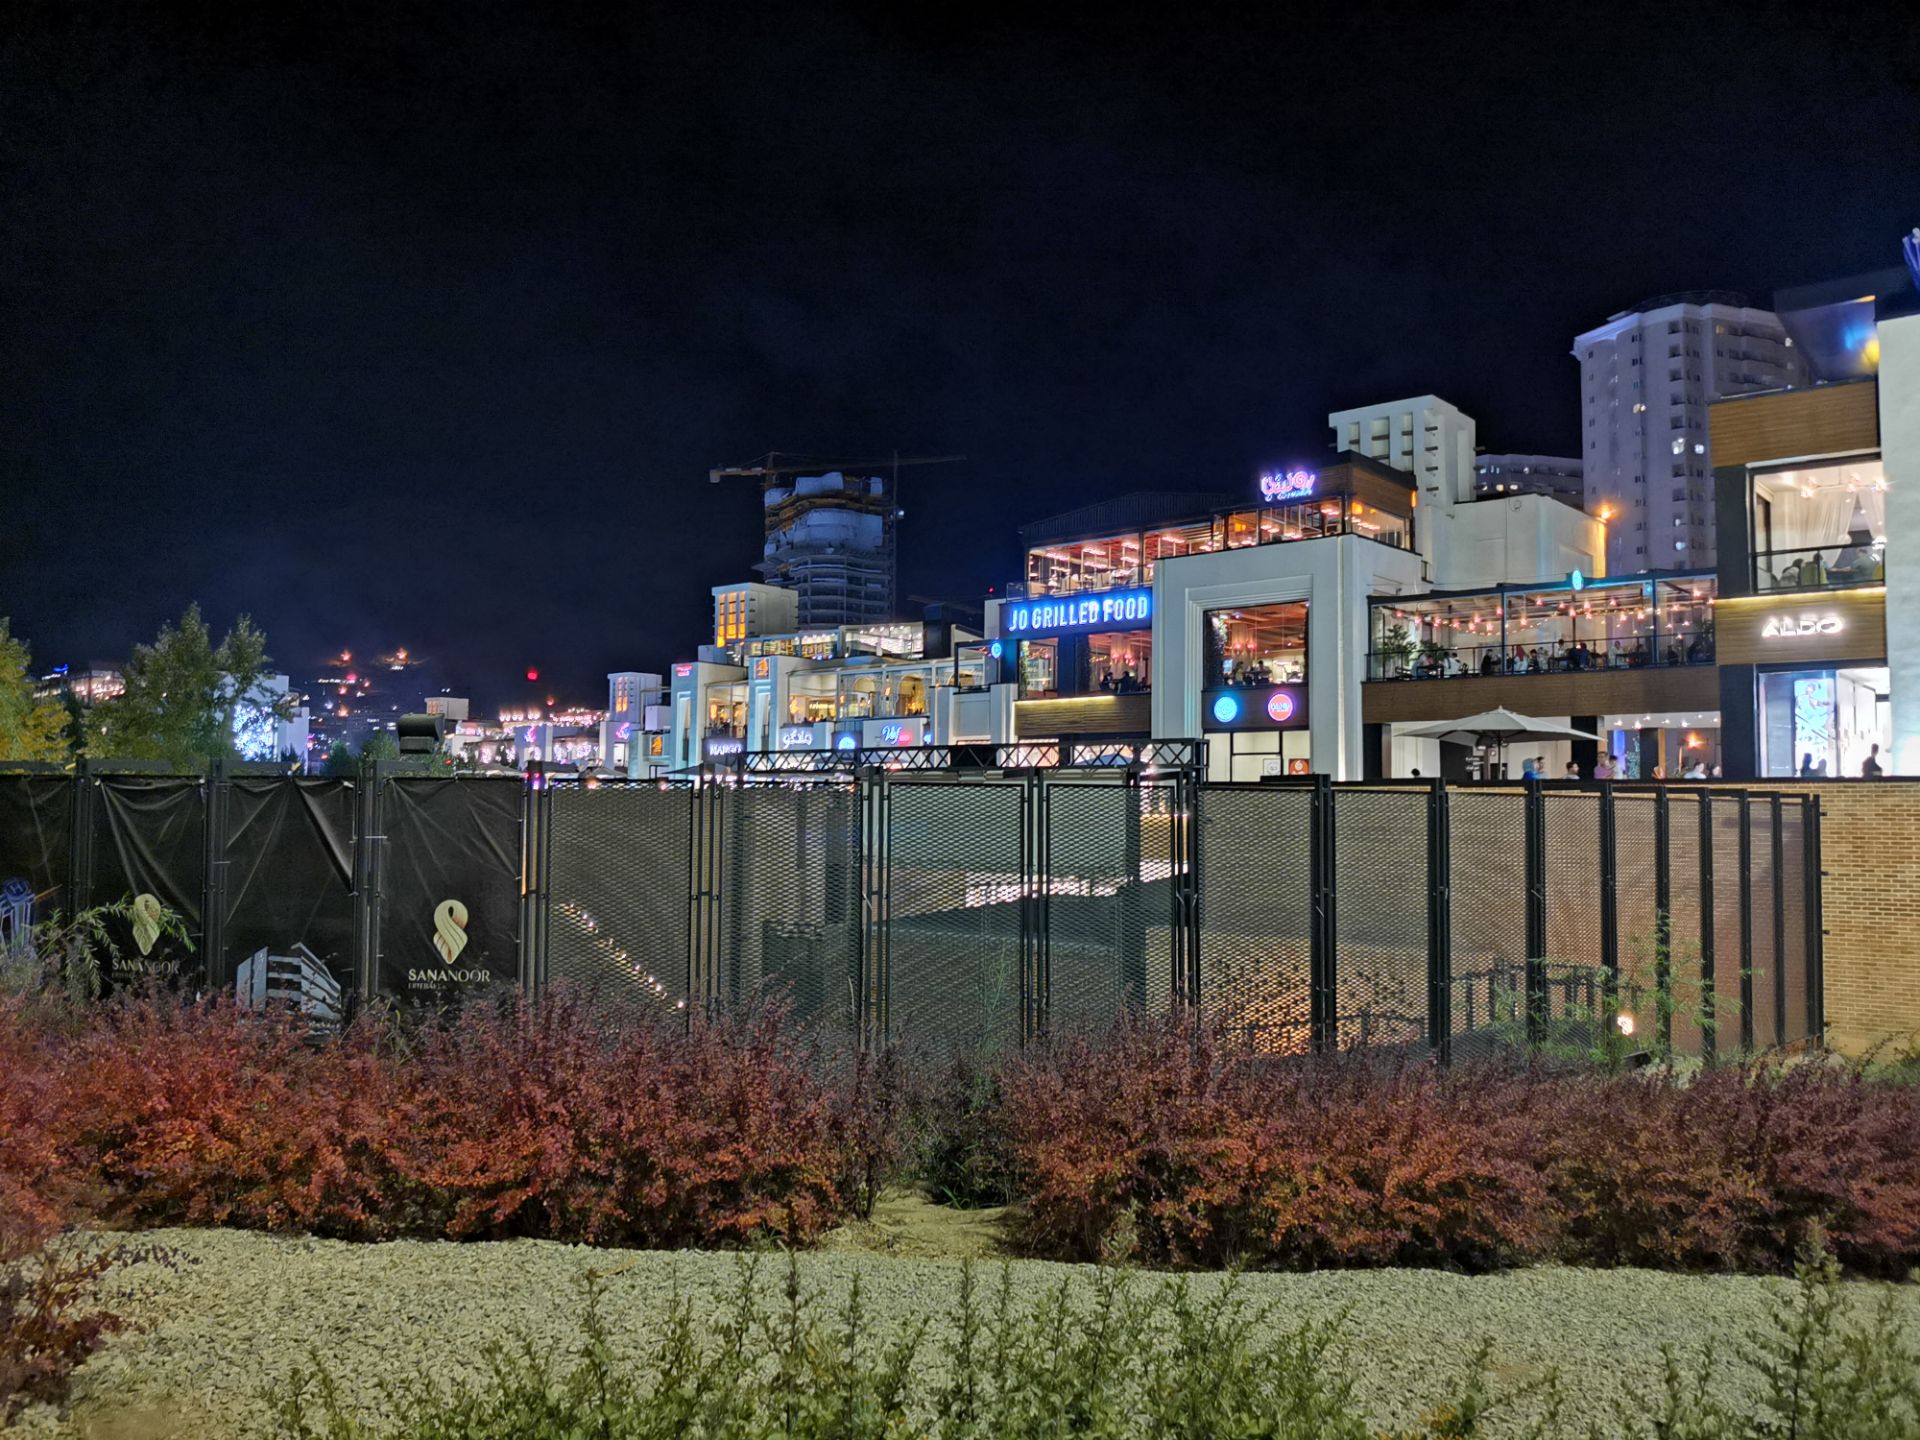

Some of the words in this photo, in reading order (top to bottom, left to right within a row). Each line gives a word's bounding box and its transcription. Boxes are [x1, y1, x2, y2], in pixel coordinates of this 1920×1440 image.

[1009, 609, 1028, 631] JO
[1031, 601, 1099, 629] GRILLED
[1102, 596, 1148, 622] FOOD
[1761, 615, 1843, 637] ALDO
[408, 968, 491, 982] SANANOOR
